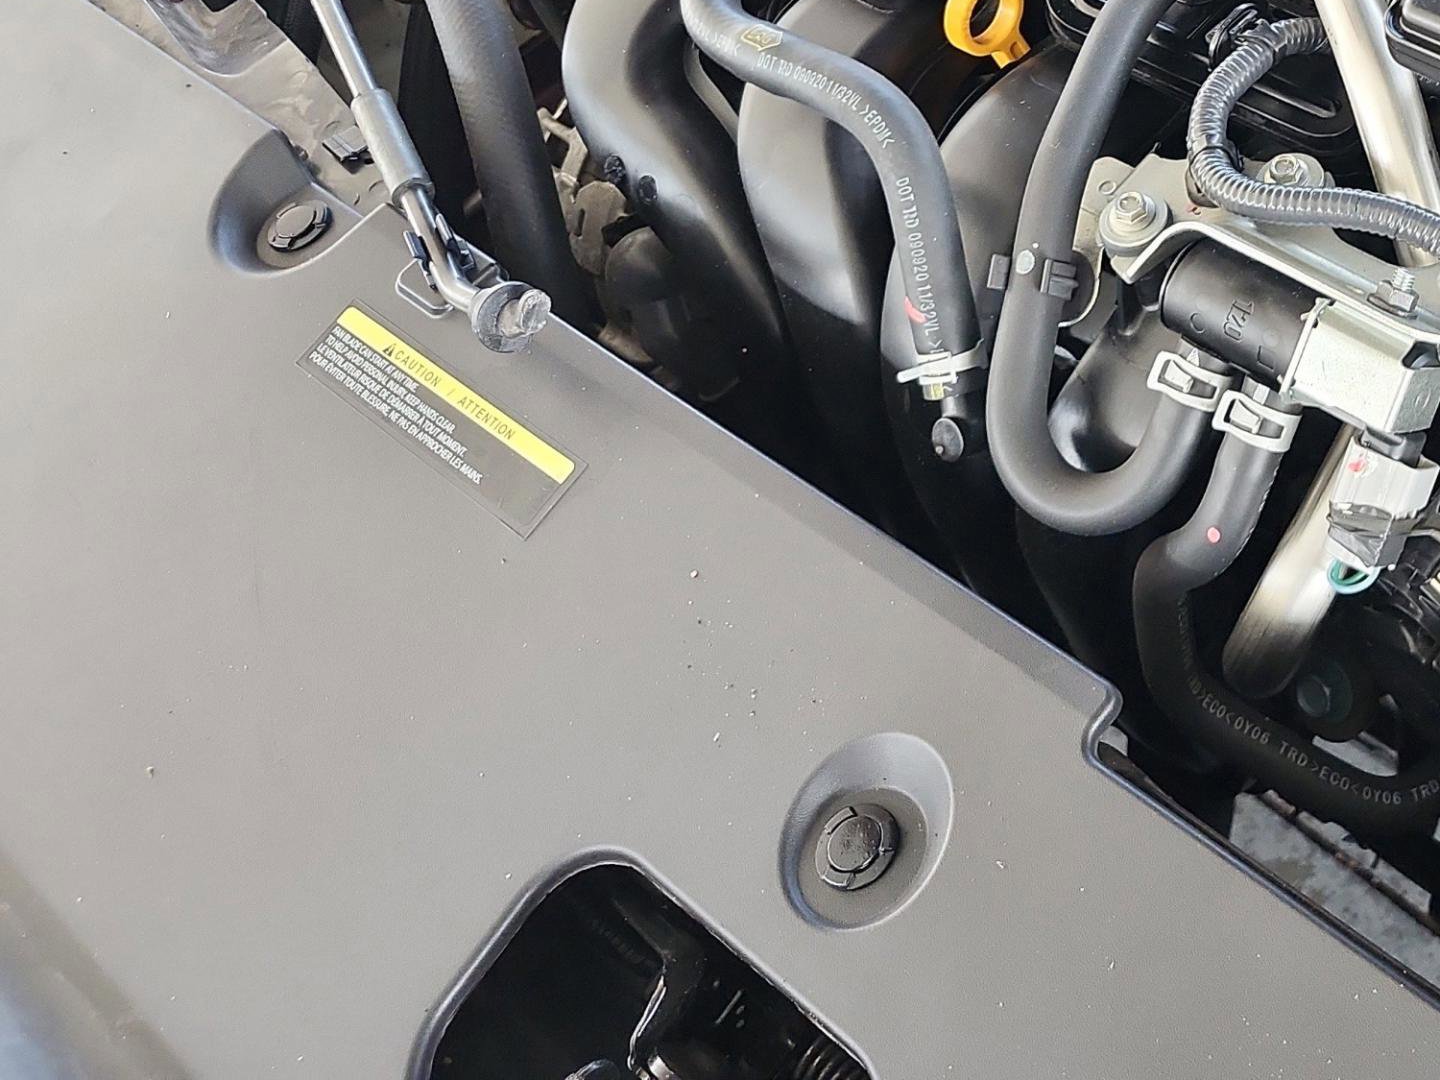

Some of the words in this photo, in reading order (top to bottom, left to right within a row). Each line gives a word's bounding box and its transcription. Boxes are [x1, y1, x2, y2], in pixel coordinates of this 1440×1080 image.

[325, 335, 337, 346] TO
[332, 341, 349, 355] HELP
[345, 350, 365, 366] AVOID
[360, 361, 391, 385] PERSONAL
[404, 393, 422, 408] KEEP
[417, 403, 439, 421] HANDS
[331, 326, 346, 339] FAN
[342, 334, 362, 350] BLADE
[358, 346, 373, 358] CAN
[369, 354, 389, 370] START
[385, 365, 395, 375] AT
[394, 350, 442, 387] CAUTION
[457, 396, 517, 440] ATTENTION
[309, 352, 328, 368] POUR
[343, 377, 365, 395] TOUTE
[388, 411, 401, 422] NE
[396, 417, 411, 430] PAS
[407, 425, 420, 437] EN
[415, 431, 453, 461] APPROCHER
[449, 456, 463, 468] LES
[317, 343, 328, 353] LE
[323, 348, 362, 378] VENTILATEUR
[358, 374, 383, 394] RISQUE
[378, 389, 391, 400] DE
[421, 421, 441, 437] TOUT
[436, 431, 468, 457] MOMENT.
